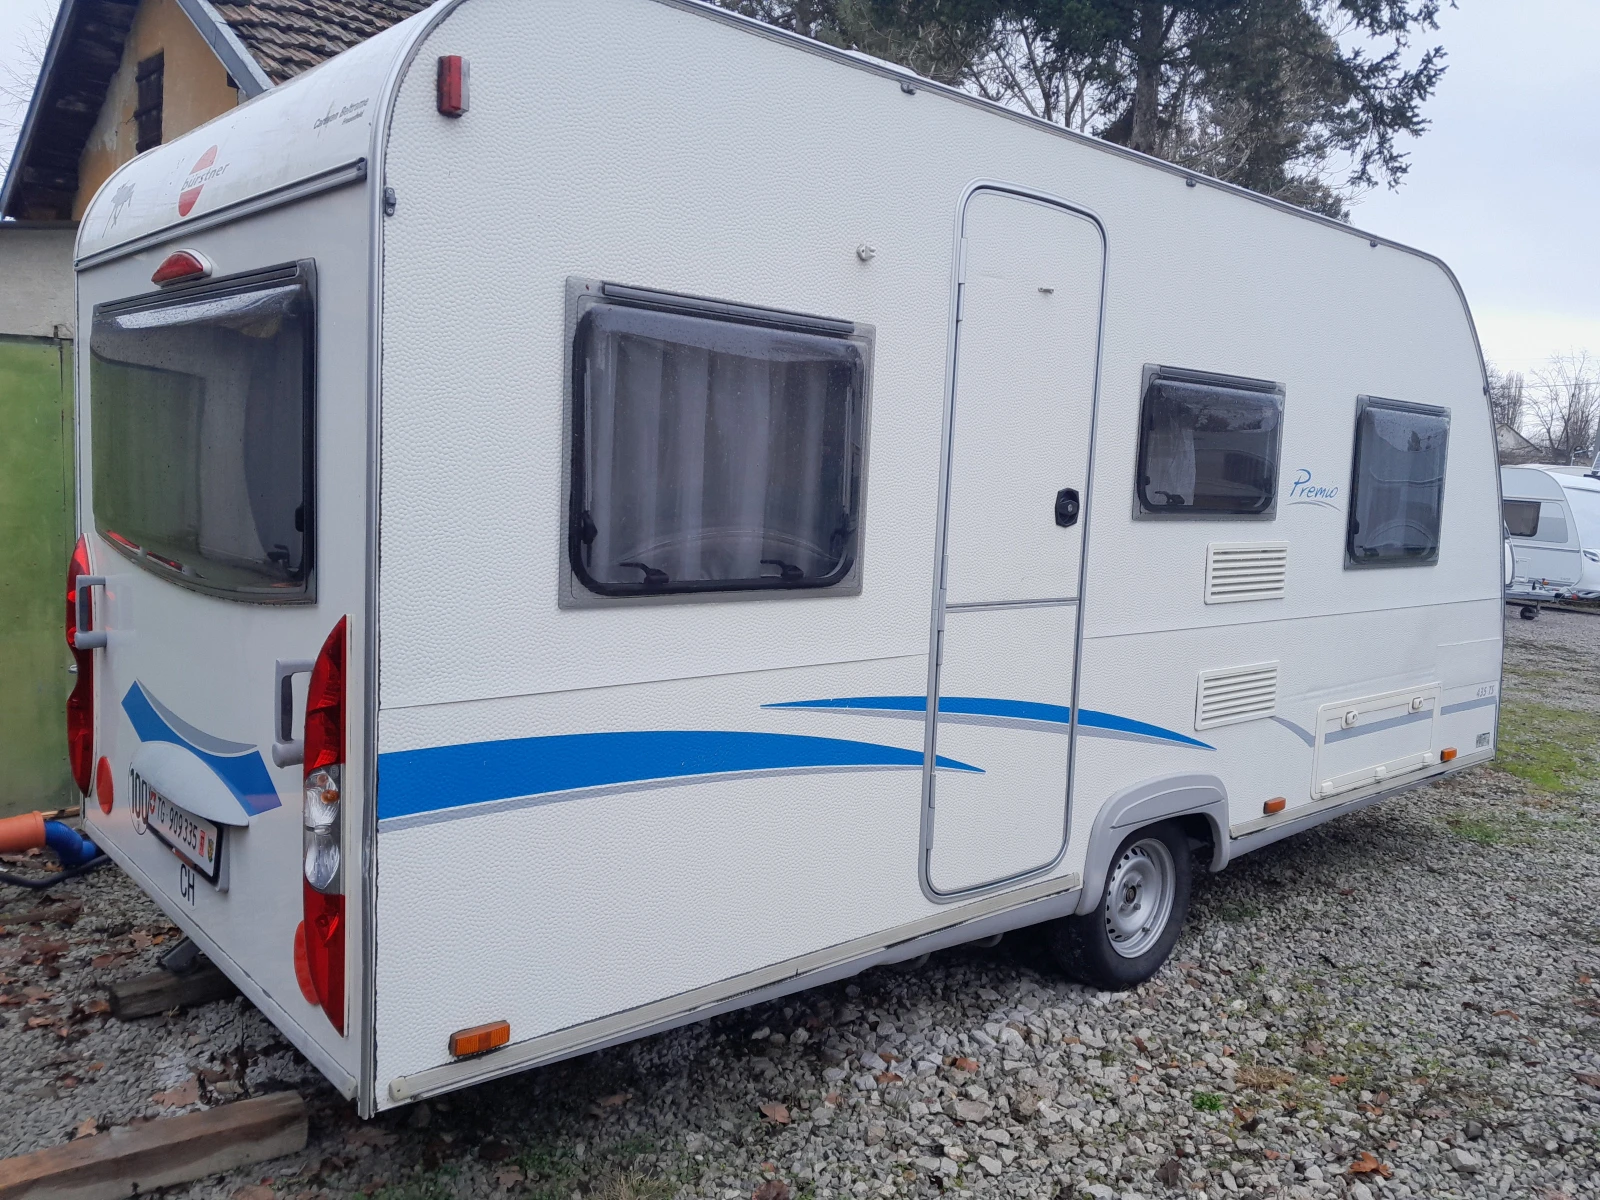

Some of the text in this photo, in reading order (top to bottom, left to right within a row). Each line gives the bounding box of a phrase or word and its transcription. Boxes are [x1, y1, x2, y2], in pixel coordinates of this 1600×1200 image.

[181, 163, 230, 191] bürstner
[1290, 468, 1339, 499] Premio
[1476, 686, 1488, 698] 435
[130, 768, 148, 825] 100
[180, 863, 195, 906] CH
